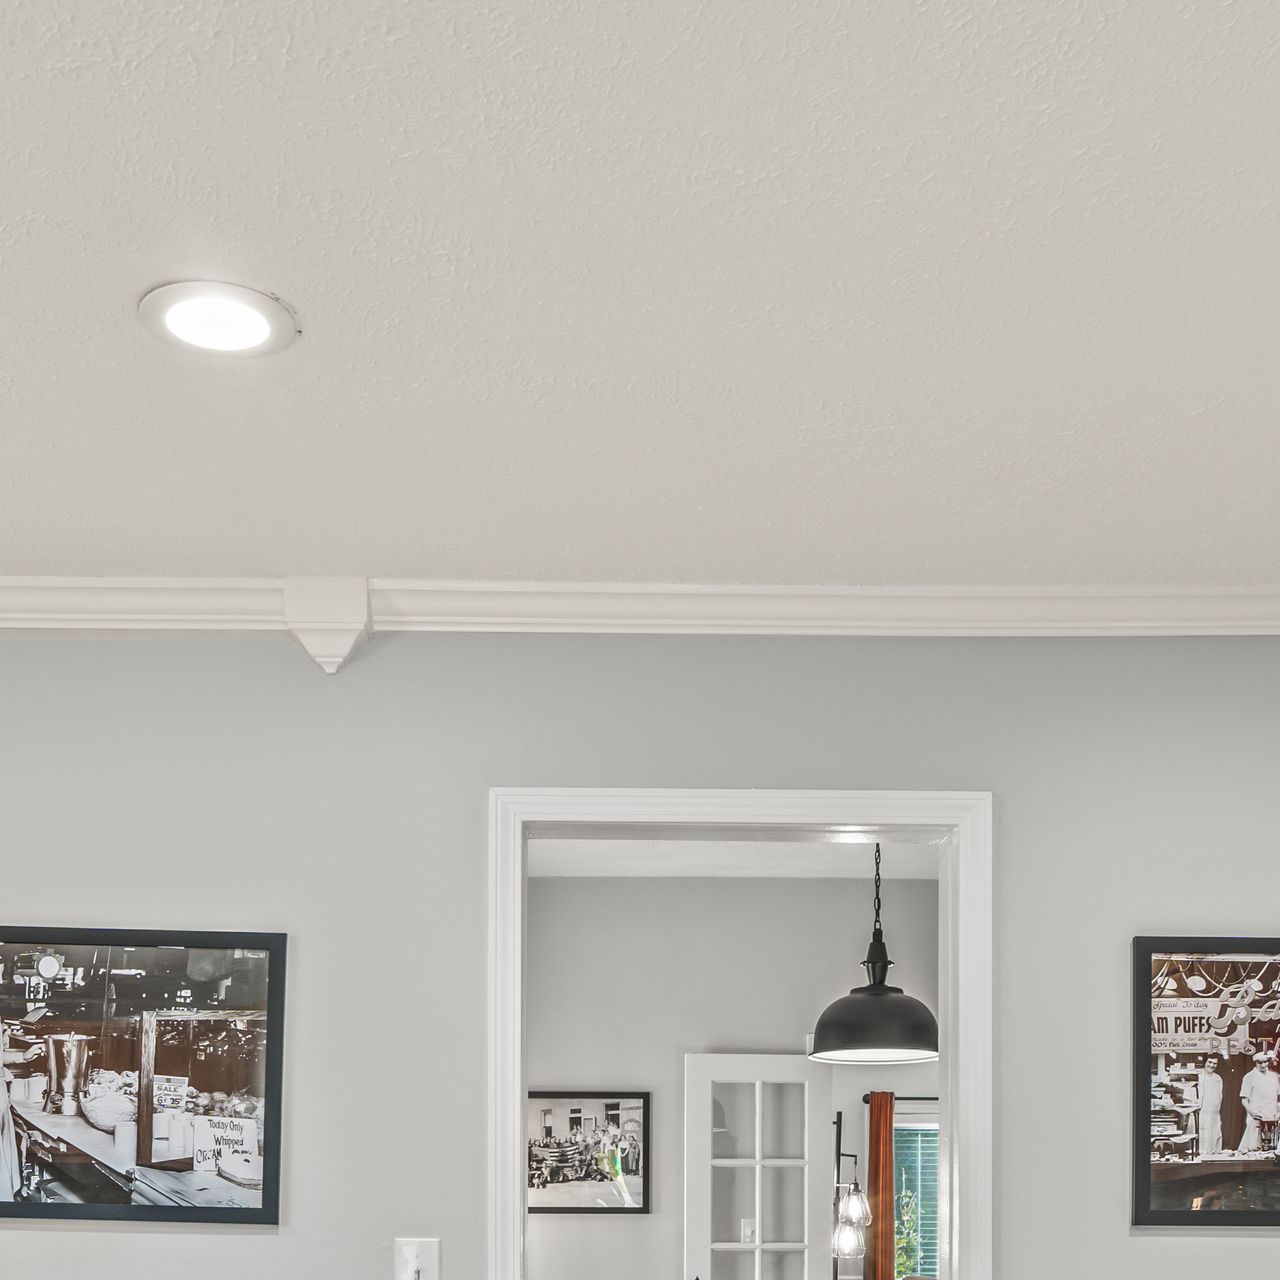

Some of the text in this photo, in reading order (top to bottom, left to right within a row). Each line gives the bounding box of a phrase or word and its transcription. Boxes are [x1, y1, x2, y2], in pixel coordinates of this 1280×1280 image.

[1152, 1000, 1178, 1010] Special
[1174, 1016, 1213, 1034] PUFFS
[156, 1085, 179, 1093] SALE
[208, 1119, 244, 1135] Today Only
[214, 1135, 244, 1149] Whipped
